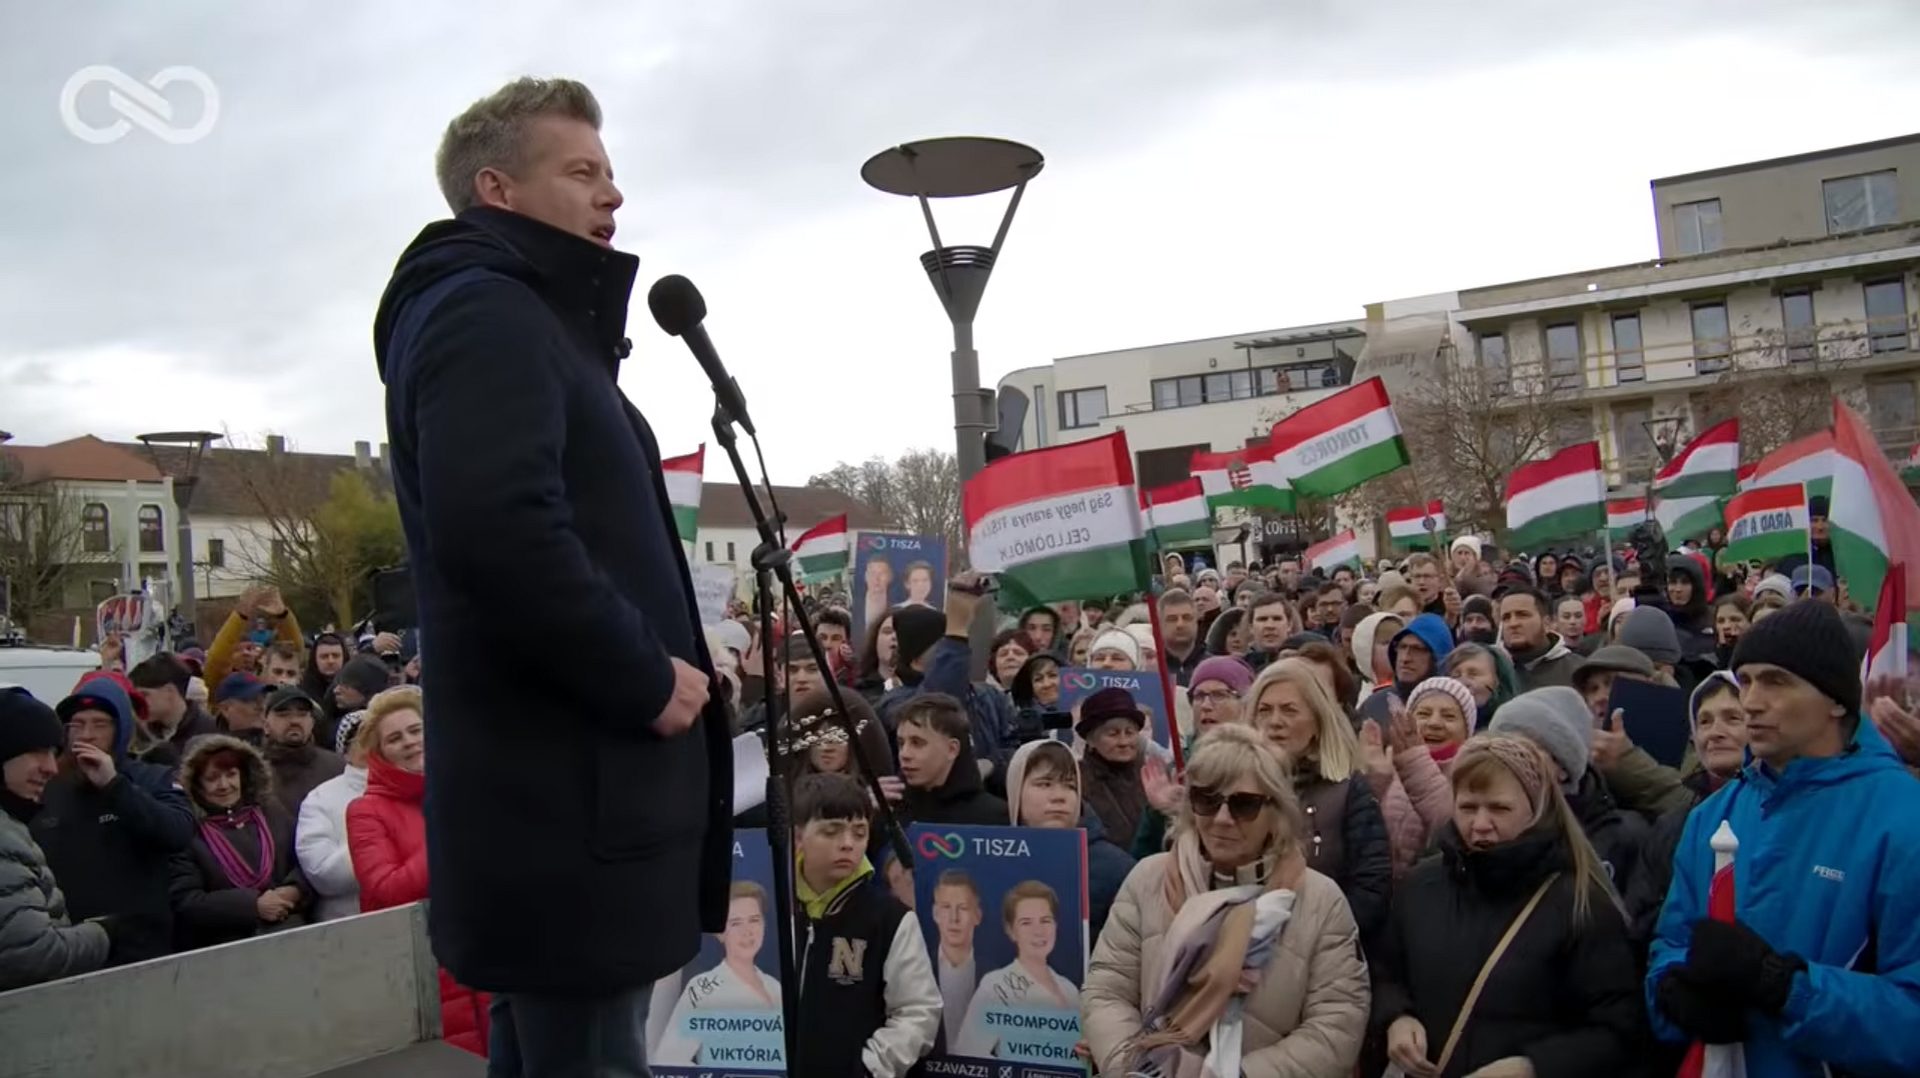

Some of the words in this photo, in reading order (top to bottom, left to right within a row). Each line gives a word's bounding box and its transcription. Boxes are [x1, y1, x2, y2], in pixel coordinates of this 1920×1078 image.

[890, 539, 921, 550] TISZA
[1101, 675, 1140, 689] TISZA
[972, 837, 1031, 857] TISZA
[828, 937, 867, 981] N
[689, 1015, 783, 1033] STROMPOVÁ
[986, 1011, 1080, 1033] STROMPOVÁ
[709, 1045, 782, 1062] VIKTÓRIA
[1007, 1041, 1080, 1061] VIKTÓRIA
[925, 1060, 989, 1078] SZAVAZZ!
